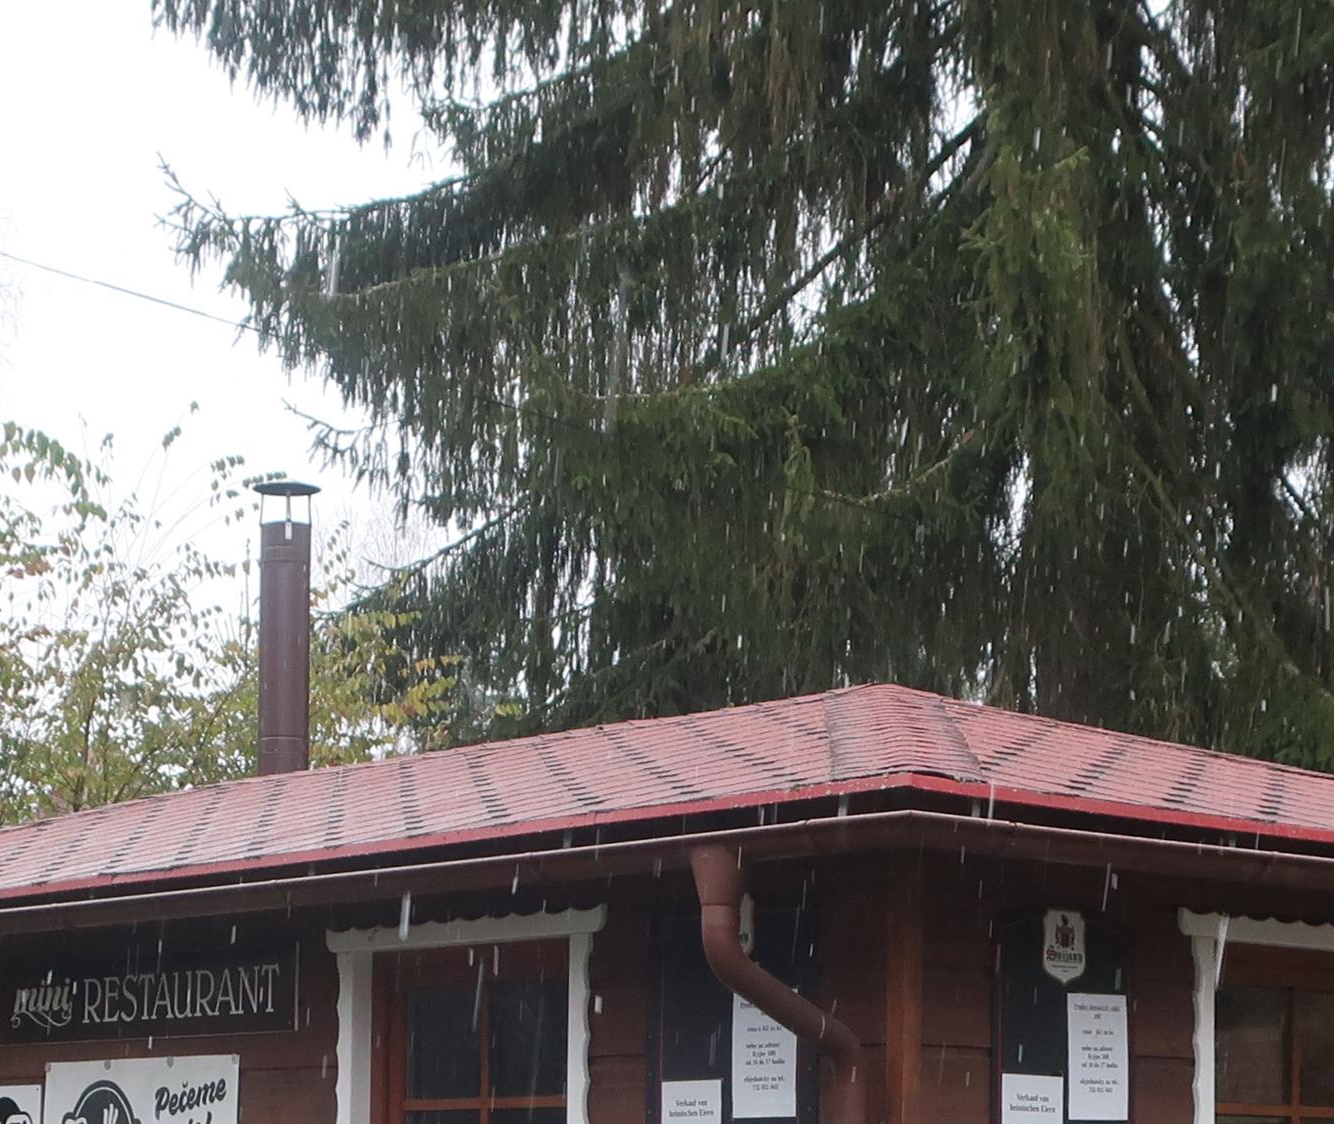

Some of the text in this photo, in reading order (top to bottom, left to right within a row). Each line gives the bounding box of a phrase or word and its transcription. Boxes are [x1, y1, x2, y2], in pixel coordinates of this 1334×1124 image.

[11, 963, 280, 1029] mini RESTAURANT
[154, 1077, 227, 1121] Pečeme
